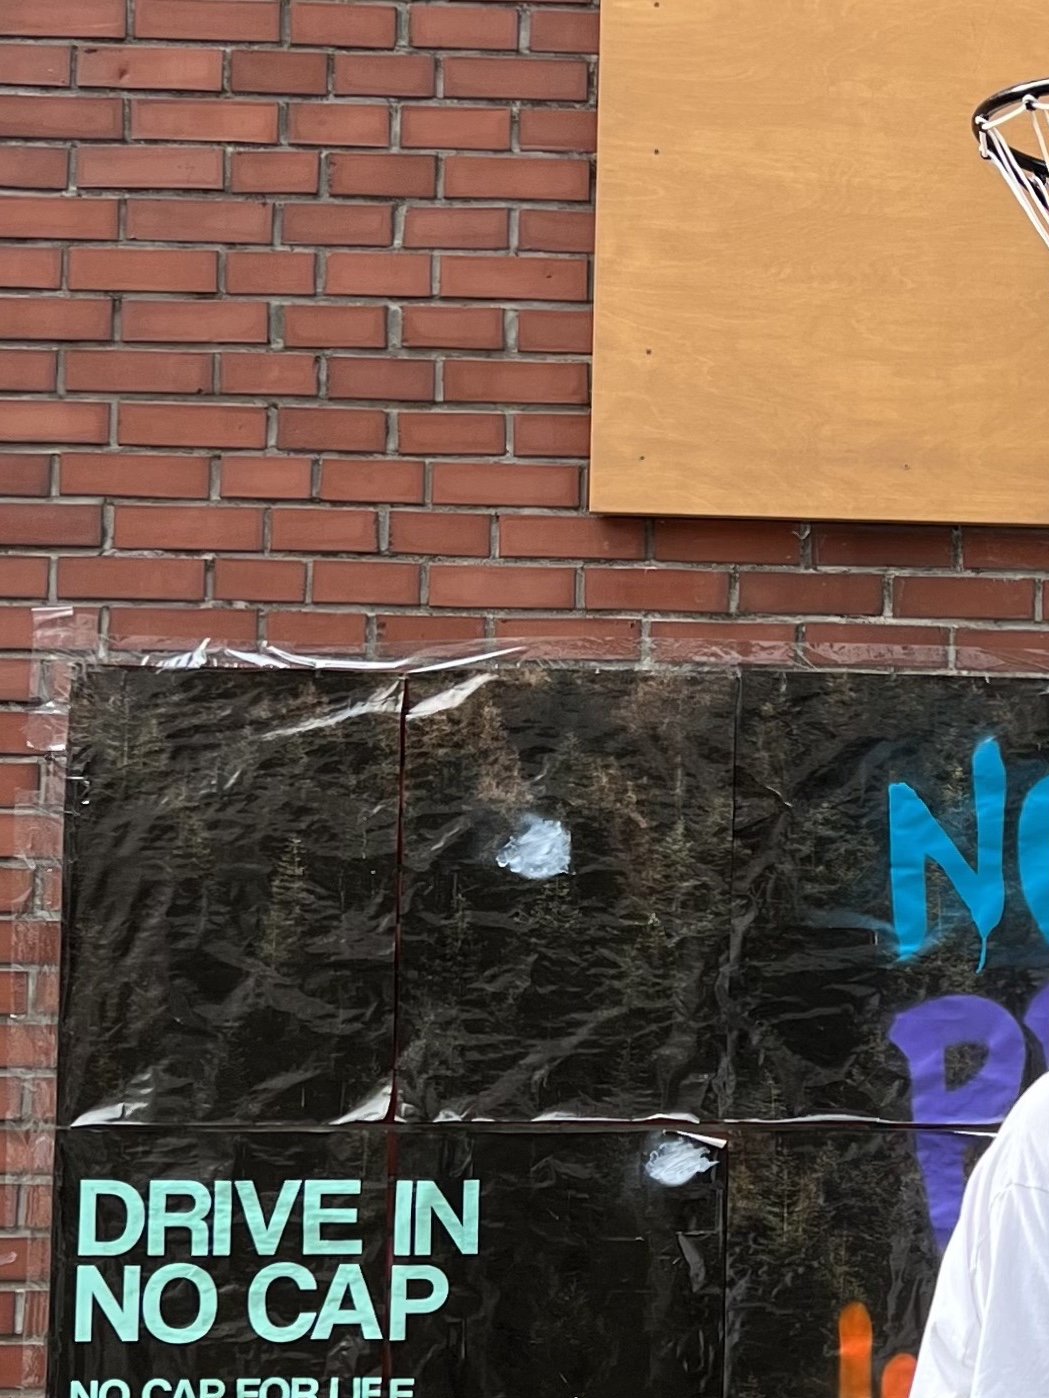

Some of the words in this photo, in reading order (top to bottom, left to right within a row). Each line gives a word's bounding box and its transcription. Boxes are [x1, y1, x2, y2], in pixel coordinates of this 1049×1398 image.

[78, 1179, 363, 1257] DRIVE
[393, 1179, 480, 1256] IN
[74, 1264, 219, 1344] NO
[247, 1263, 450, 1342] CAP
